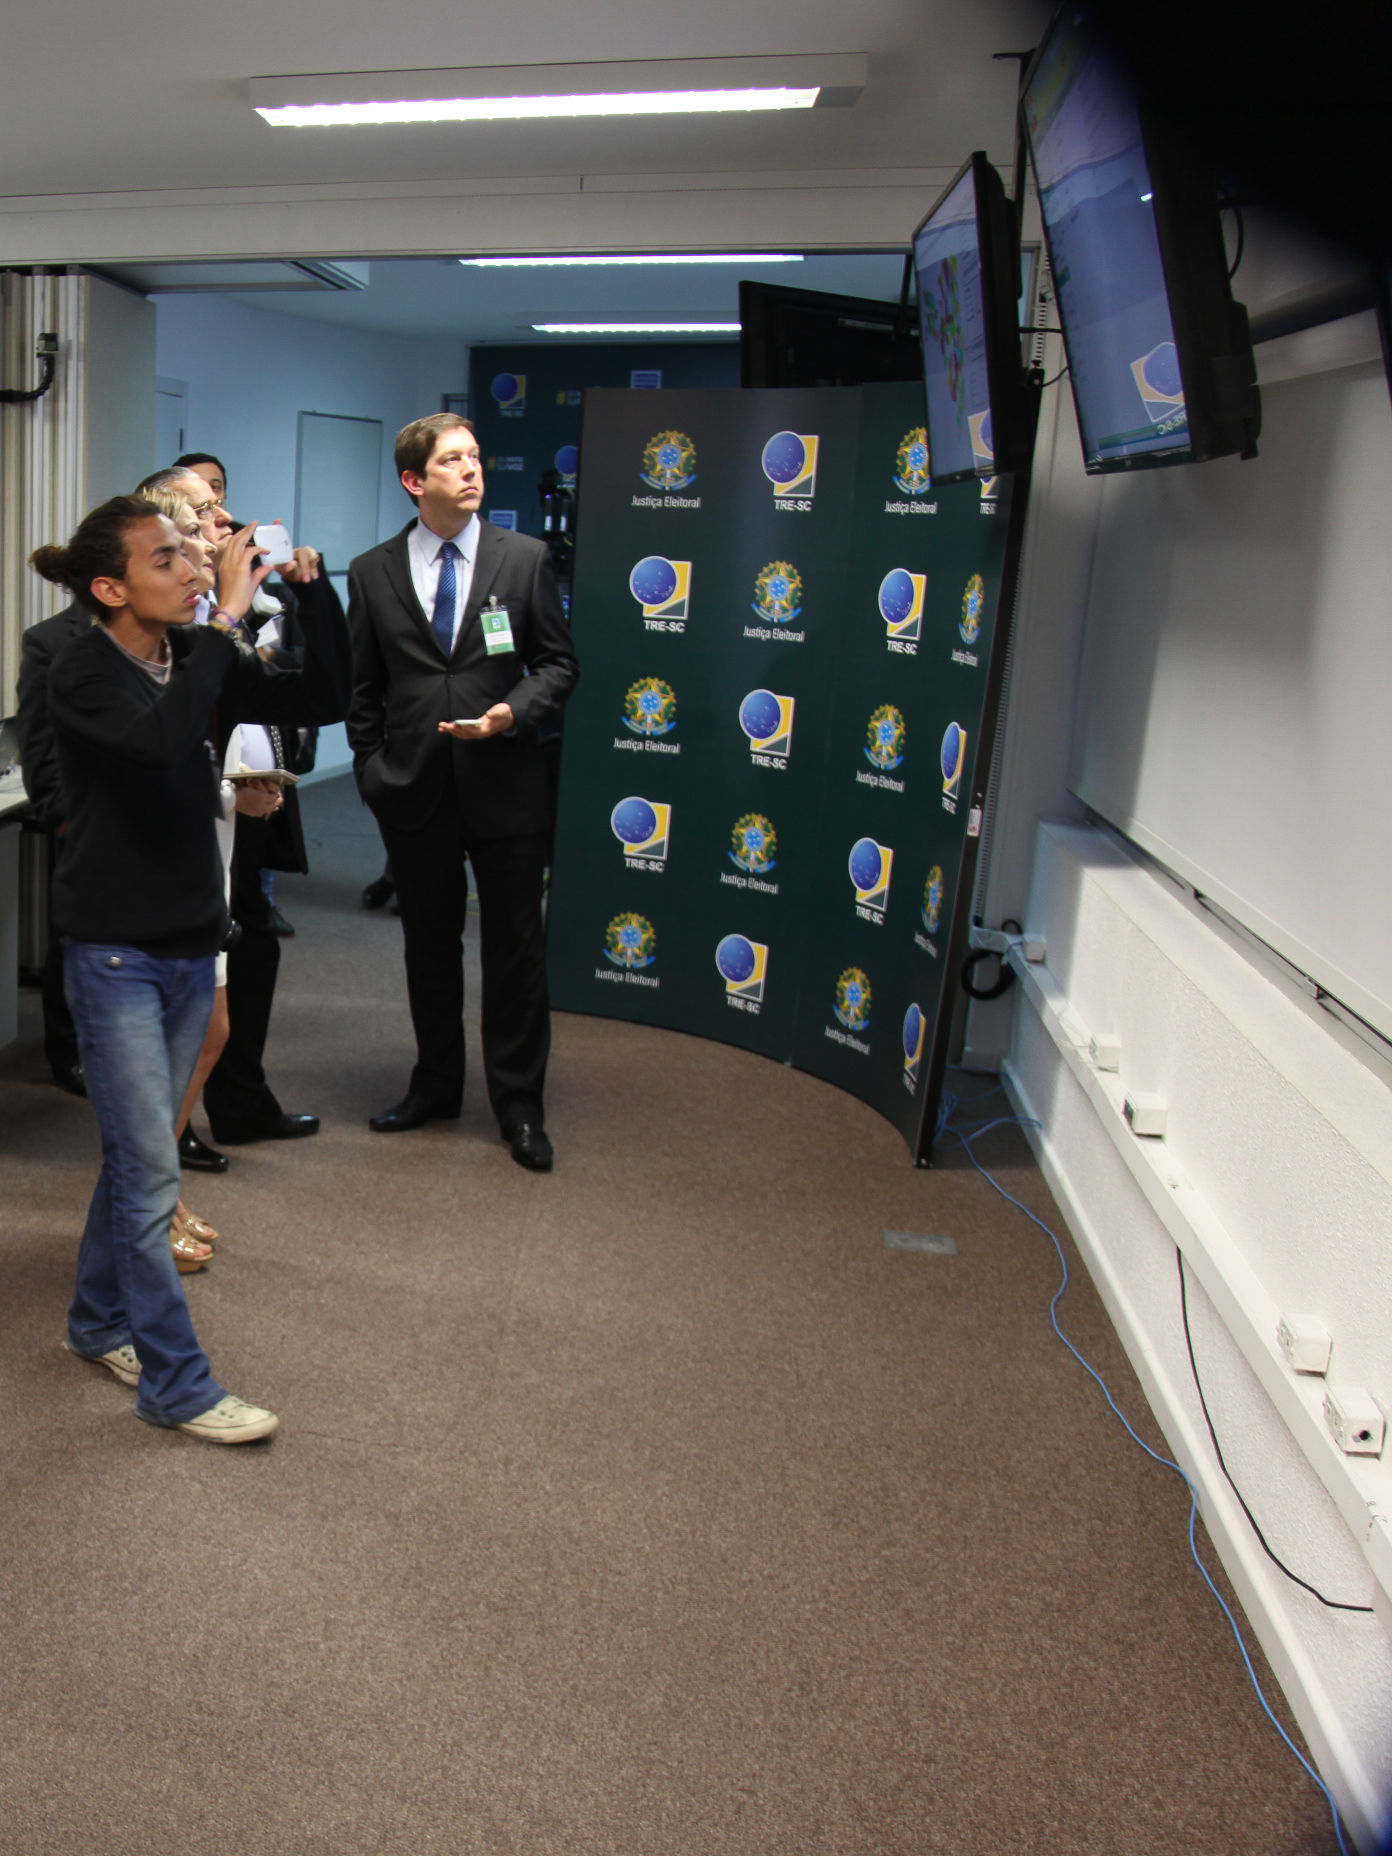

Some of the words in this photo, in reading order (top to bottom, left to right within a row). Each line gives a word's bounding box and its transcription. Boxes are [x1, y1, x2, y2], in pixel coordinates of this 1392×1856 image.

[632, 495, 662, 509] Justiça
[664, 496, 701, 509] Eleitoral
[774, 499, 812, 512] TRE-SC
[644, 619, 685, 633] TRE-SC
[743, 626, 771, 642] Justiça
[772, 628, 805, 642] Eleitoral
[886, 640, 917, 655] TRE-SC
[613, 737, 643, 753] Justiça
[644, 739, 681, 755] Eleitoral
[751, 754, 788, 770] TRE-SC
[856, 770, 879, 788] Justiça
[879, 775, 905, 793] Eleitoral
[625, 857, 665, 873] TRE-SC
[720, 871, 747, 889] Justiça
[748, 876, 779, 895] Eleitoral
[855, 905, 884, 925] TRE-SC
[595, 968, 624, 985] Justiça
[626, 972, 659, 988] Eleitoral
[727, 995, 761, 1015] TRE-SC
